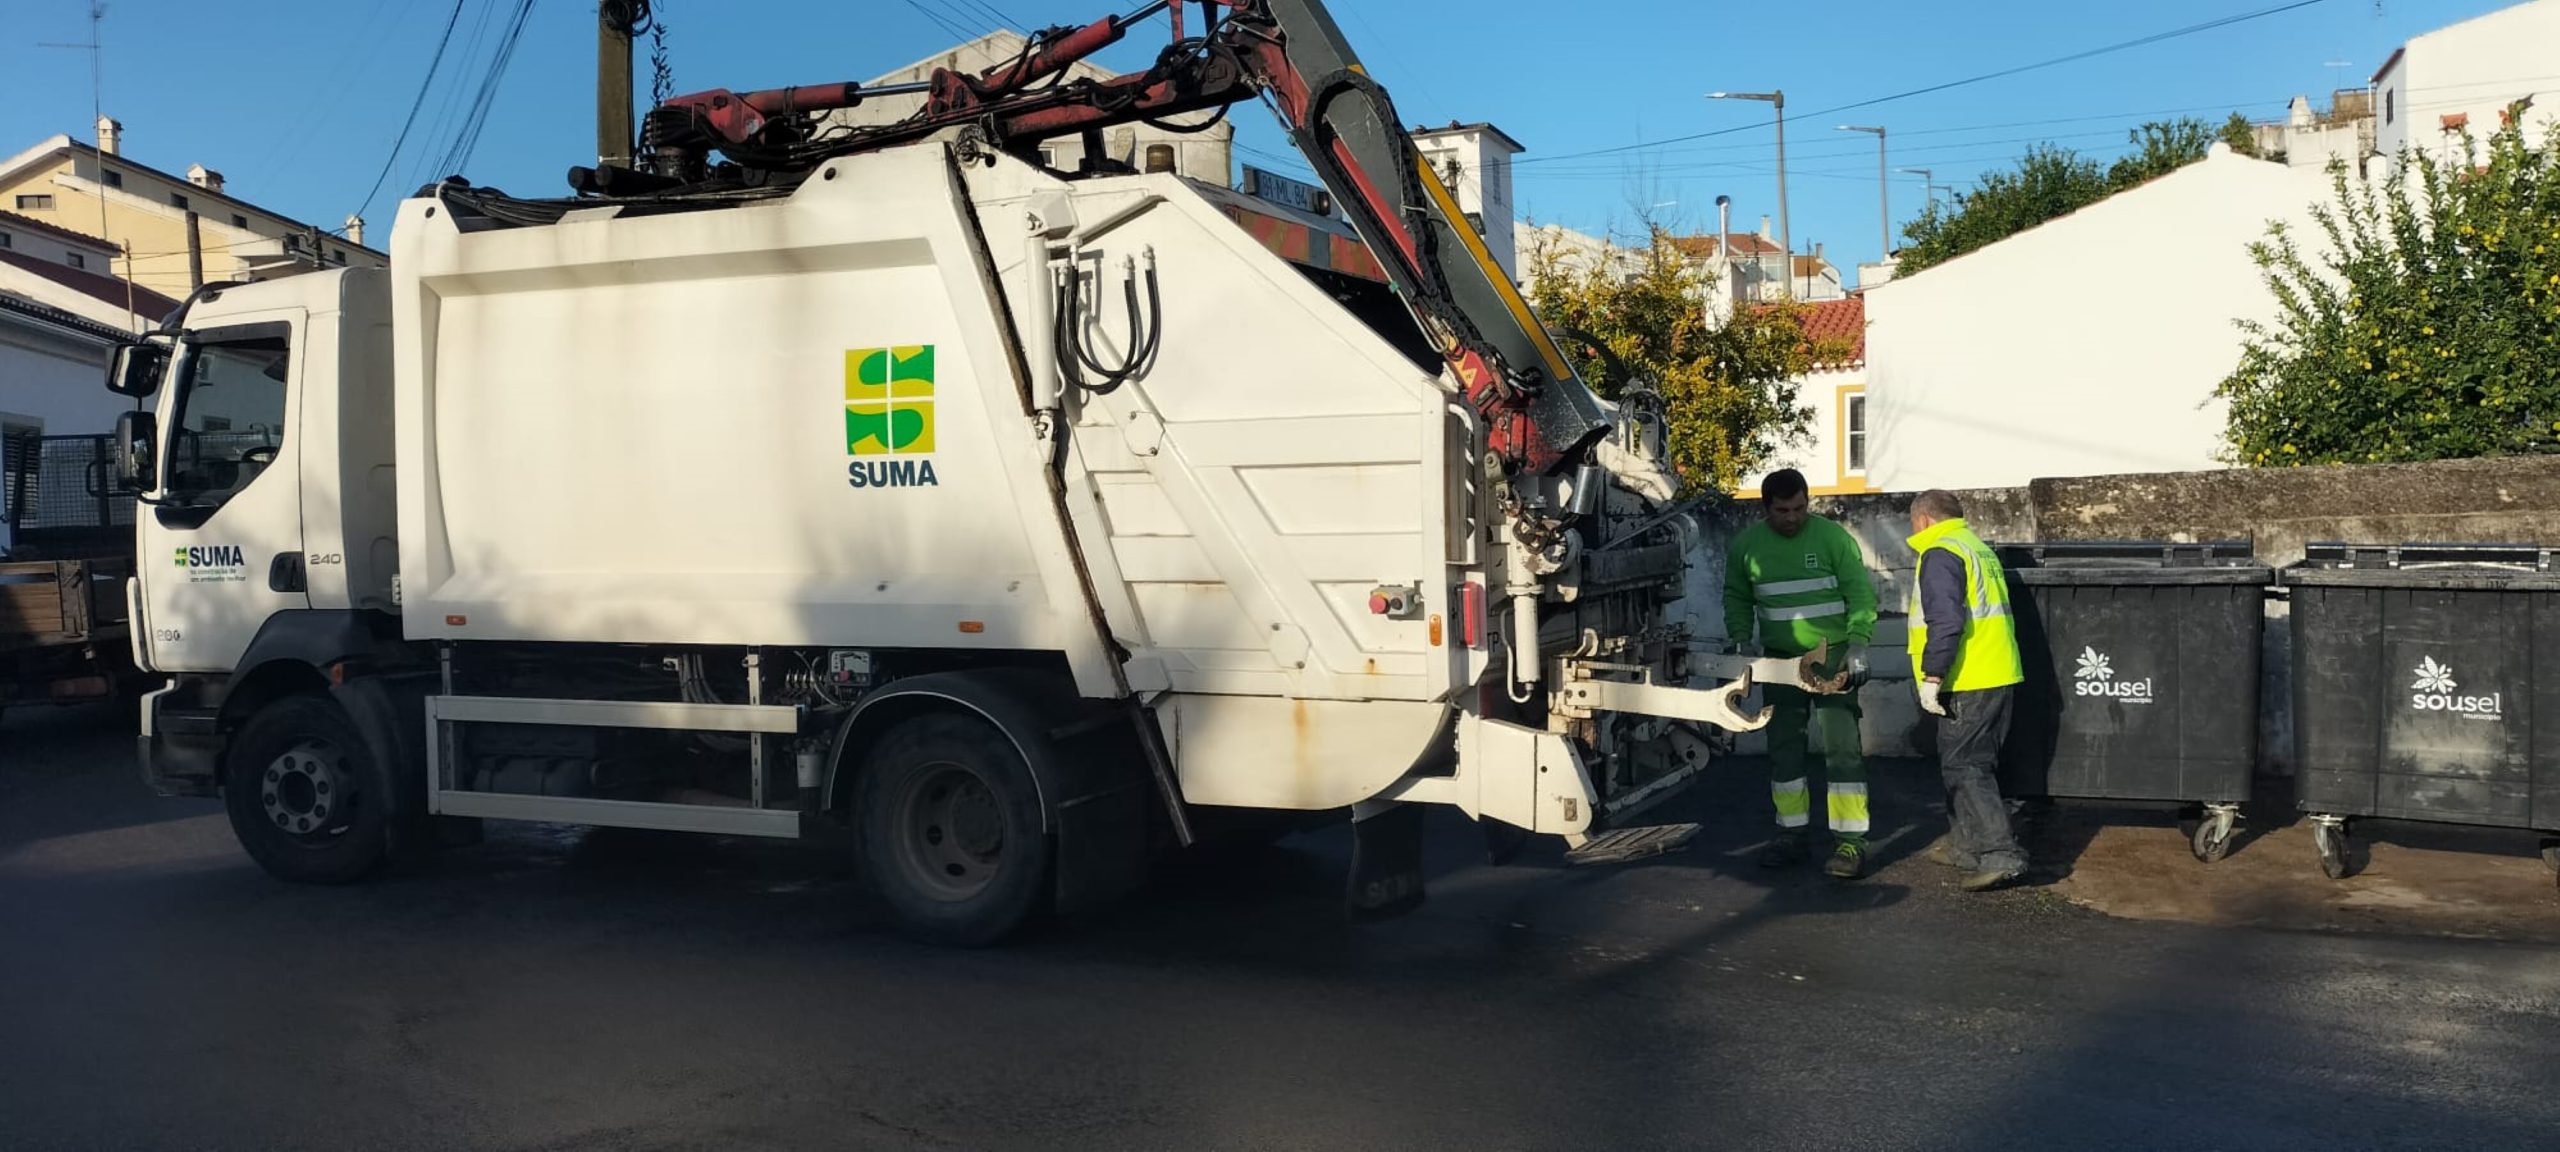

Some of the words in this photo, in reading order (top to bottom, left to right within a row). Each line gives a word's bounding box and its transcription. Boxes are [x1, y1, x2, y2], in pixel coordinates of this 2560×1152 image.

[848, 459, 939, 488] SUMA
[189, 545, 245, 567] SUMA
[310, 553, 342, 565] 240
[2075, 677, 2153, 696] sousel
[2412, 692, 2502, 713] sousel
